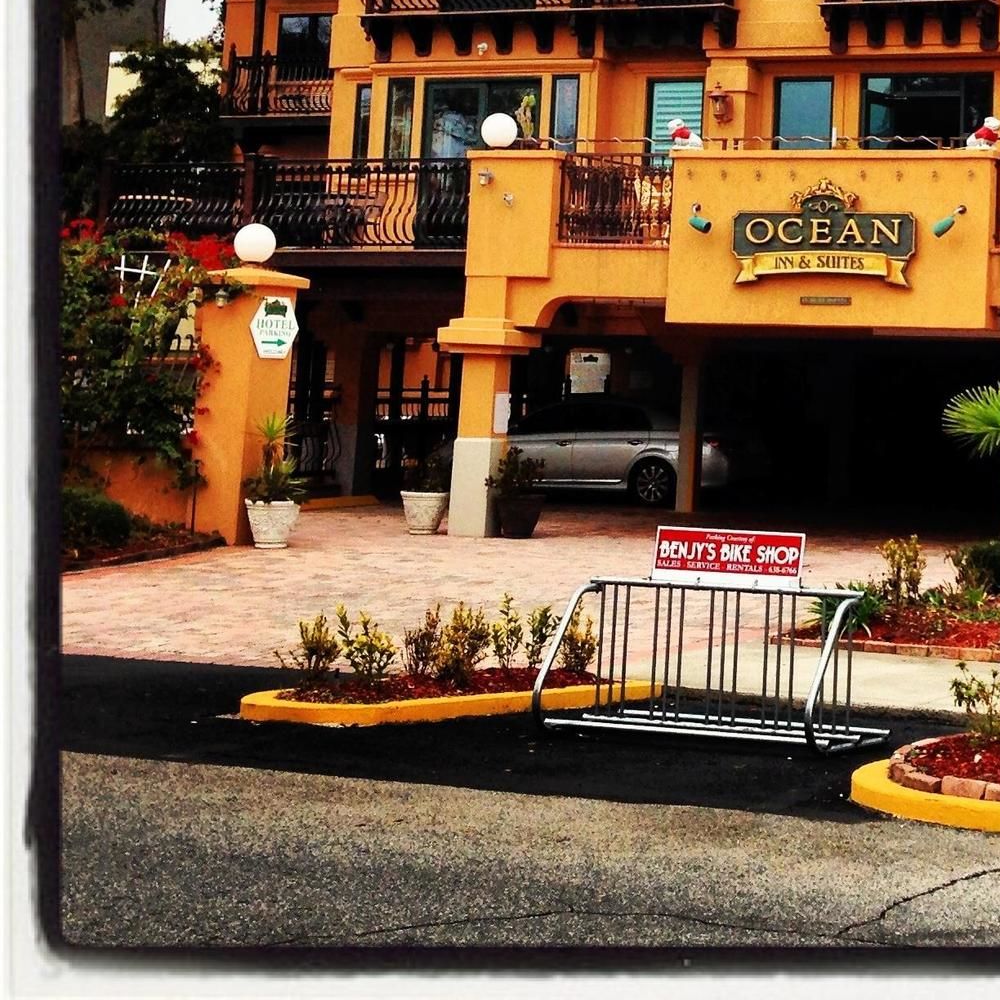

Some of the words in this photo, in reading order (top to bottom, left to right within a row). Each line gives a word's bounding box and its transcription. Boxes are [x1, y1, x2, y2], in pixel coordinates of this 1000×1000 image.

[745, 218, 901, 246] OCEAN
[774, 256, 794, 270] INN
[799, 255, 811, 268] &
[816, 255, 865, 270] SUITES
[256, 319, 295, 330] HOTEL
[659, 540, 717, 561] BENJY'S
[719, 543, 752, 563] BIKE
[756, 545, 800, 565] SHOP
[657, 559, 681, 568] SALES
[687, 561, 721, 570] SERVICE
[726, 563, 763, 572] RENTALS
